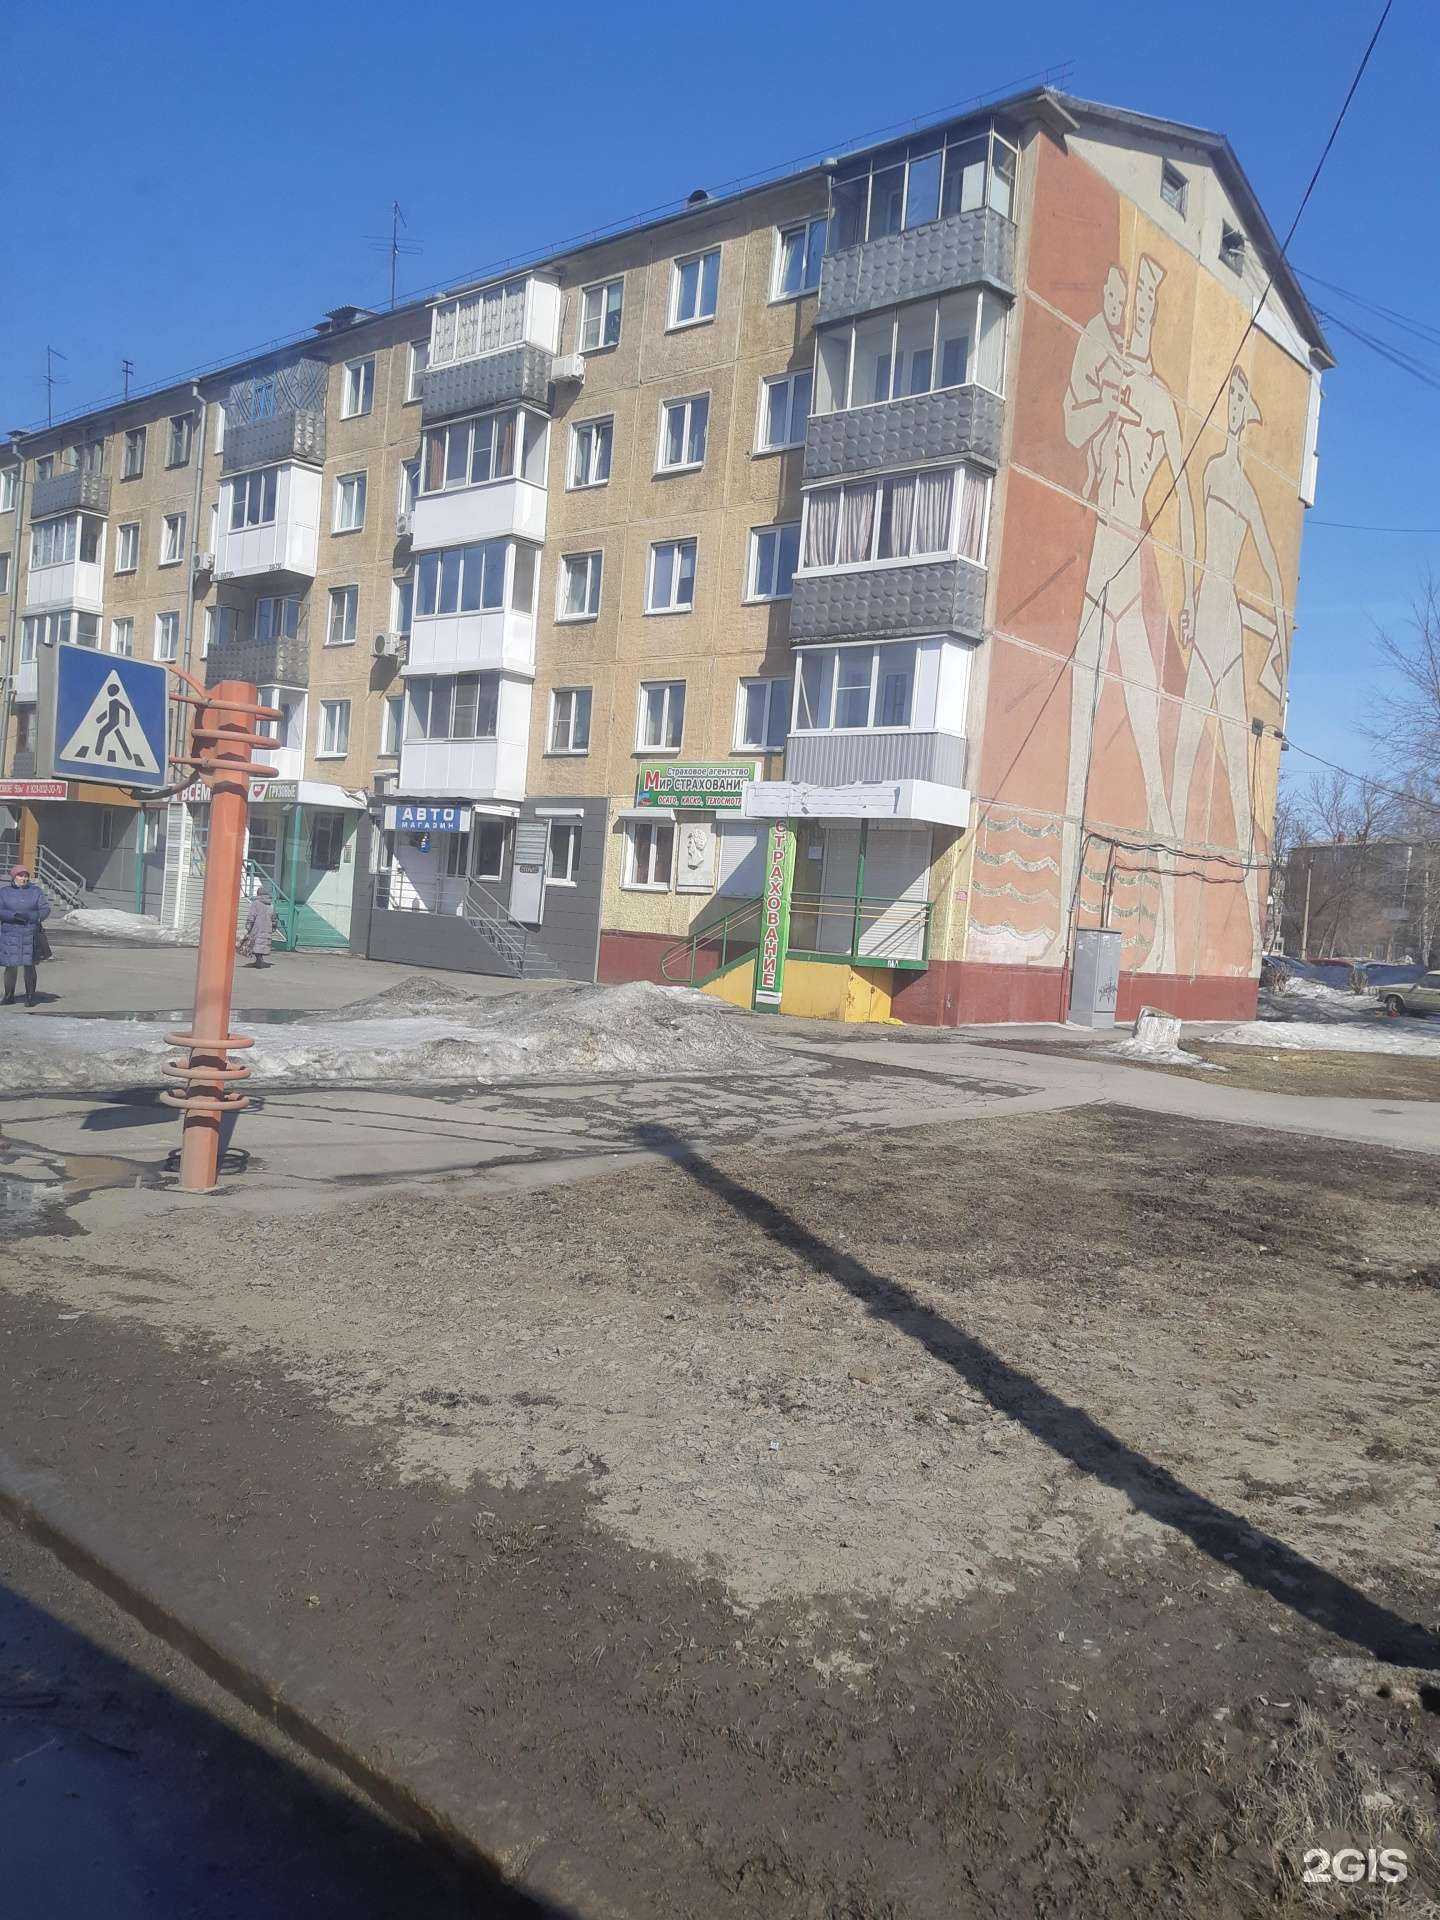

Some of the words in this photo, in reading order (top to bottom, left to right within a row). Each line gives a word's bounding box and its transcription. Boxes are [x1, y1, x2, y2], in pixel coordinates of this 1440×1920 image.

[667, 767, 707, 777] Страховое
[708, 767, 749, 777] агентство
[402, 807, 455, 821] АВТО
[401, 821, 455, 830] МАГАЗИН
[762, 820, 787, 988] СТРАХОВАНИЕ
